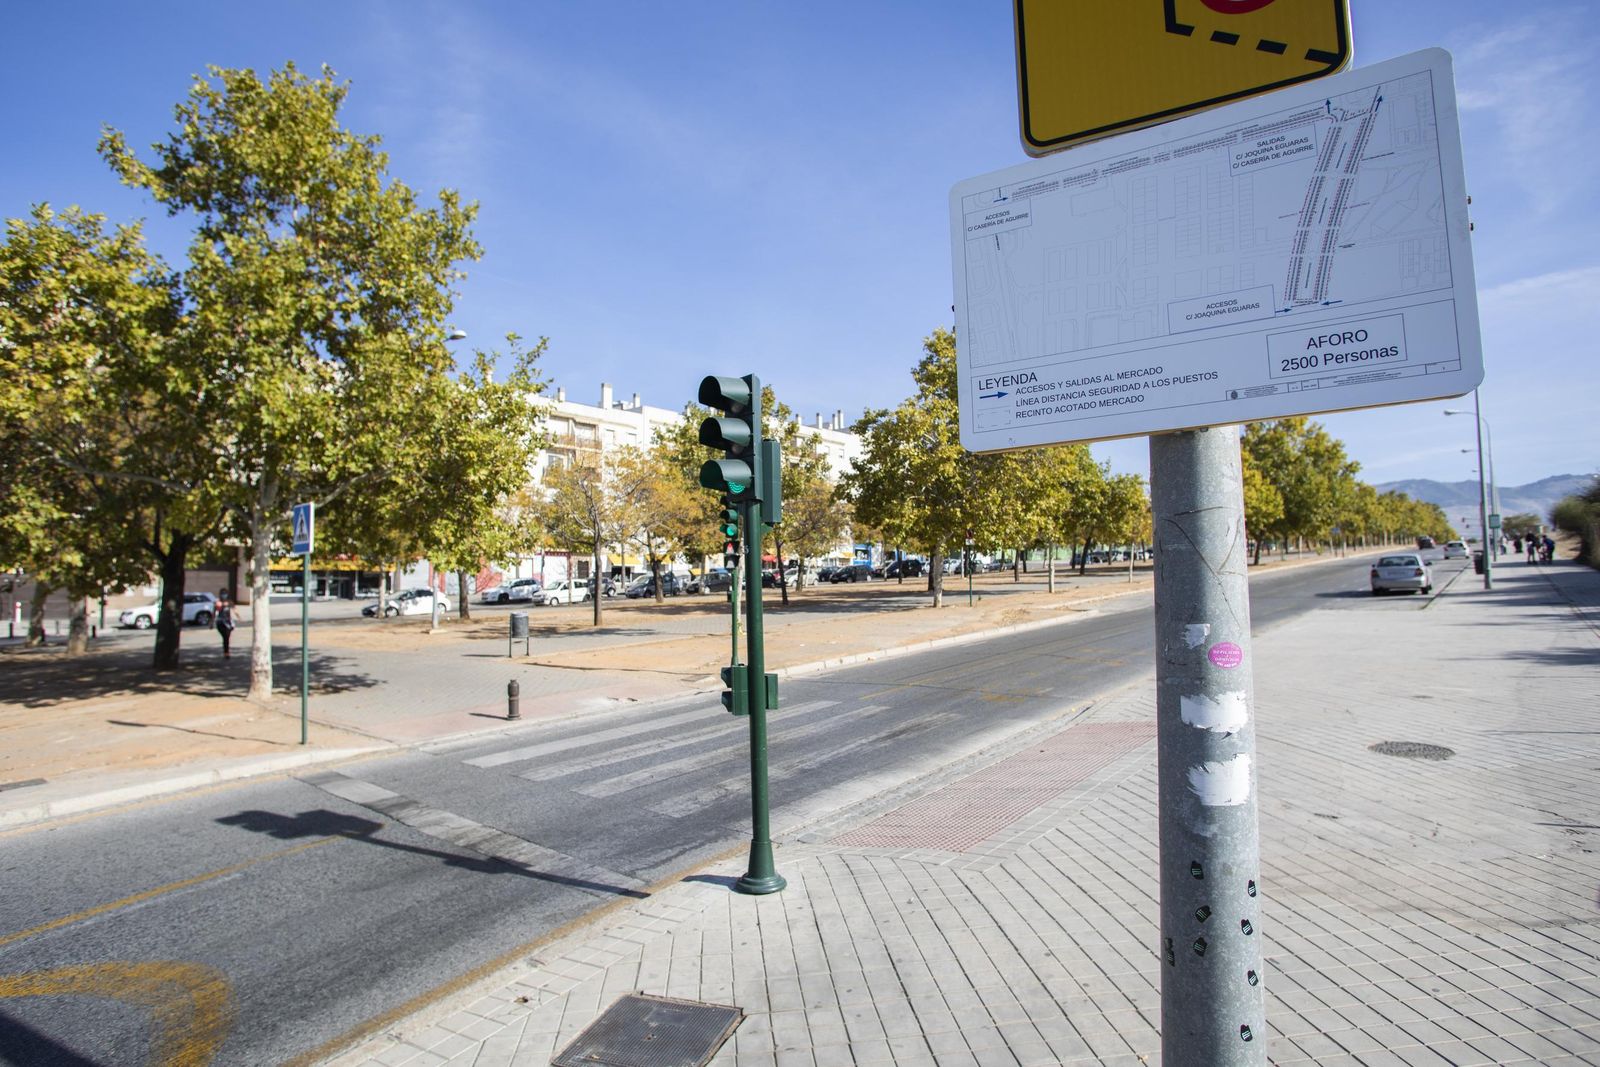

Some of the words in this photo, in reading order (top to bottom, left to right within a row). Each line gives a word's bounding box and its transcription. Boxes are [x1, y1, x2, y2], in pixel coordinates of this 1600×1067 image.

[1244, 146, 1275, 158] JOQUINA
[1275, 137, 1308, 150] EGUARAS
[1257, 136, 1285, 147] SALIDAS
[1241, 155, 1270, 167] CASERÍA
[1282, 144, 1314, 156] AGUIRRE
[985, 210, 1010, 220] ACCESOS
[1005, 213, 1029, 223] AGUIRRE
[1194, 309, 1227, 319] JOAQUINA
[1228, 303, 1260, 313] EGUARAS
[1206, 299, 1238, 310] ACCESOS
[1306, 329, 1368, 349] AFORO
[1281, 355, 1318, 371] 2500
[1323, 345, 1399, 365] Personas
[979, 372, 1038, 390] LEYENDA
[1016, 382, 1055, 395] ACCESOS
[1066, 376, 1102, 388] SALIDAS
[1117, 366, 1163, 380] MERCADO
[1016, 397, 1040, 407] LÍNEA
[1042, 390, 1086, 404] DISTANCIA
[1089, 382, 1140, 396] SEGURIDAD
[1152, 378, 1170, 388] LOS
[1172, 371, 1218, 385] PUESTOS
[1016, 407, 1052, 419] RECINTO
[1054, 401, 1097, 414] ACOTADO
[1099, 395, 1144, 407] MERCADO
